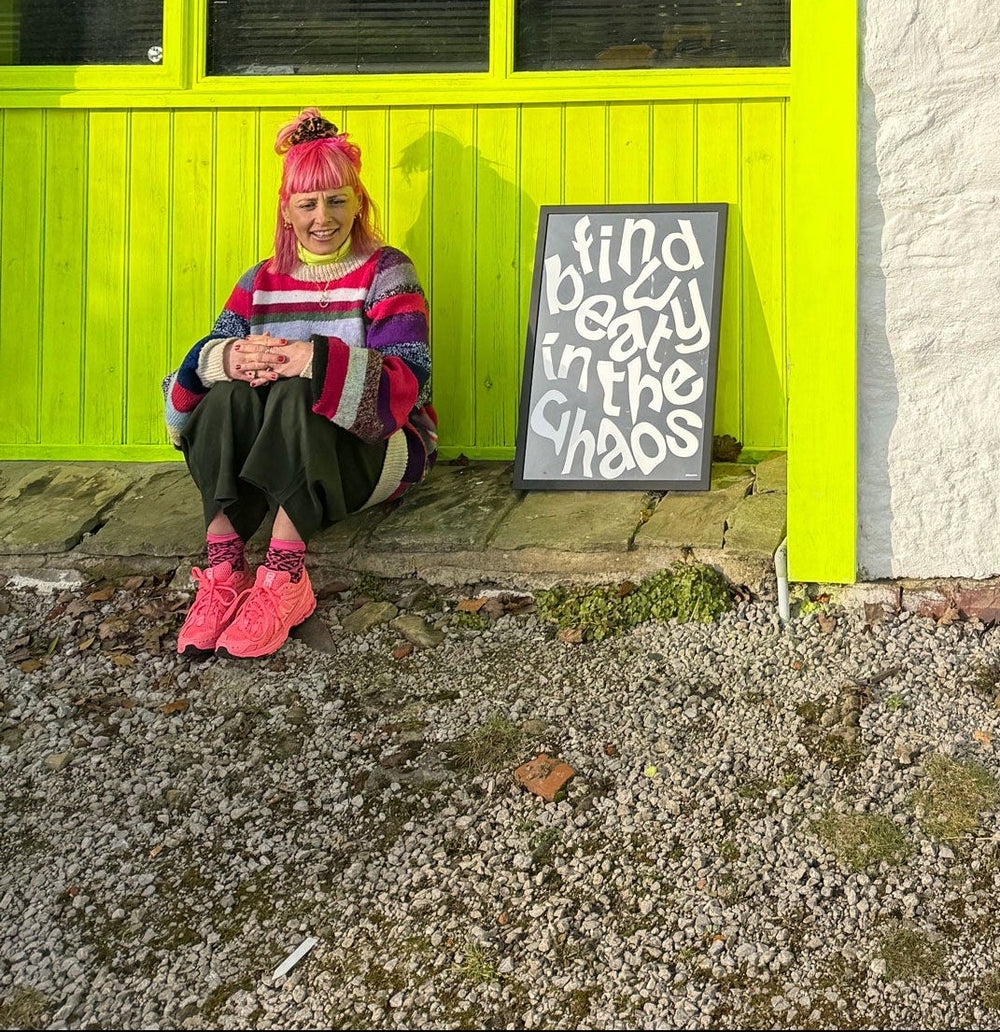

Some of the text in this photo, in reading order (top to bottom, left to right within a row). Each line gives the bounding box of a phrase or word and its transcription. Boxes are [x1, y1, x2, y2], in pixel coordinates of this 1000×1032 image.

[572, 215, 705, 284] find
[544, 254, 711, 372] beauty
[542, 332, 593, 392] in
[597, 356, 704, 425] the
[530, 389, 703, 480] chaos
